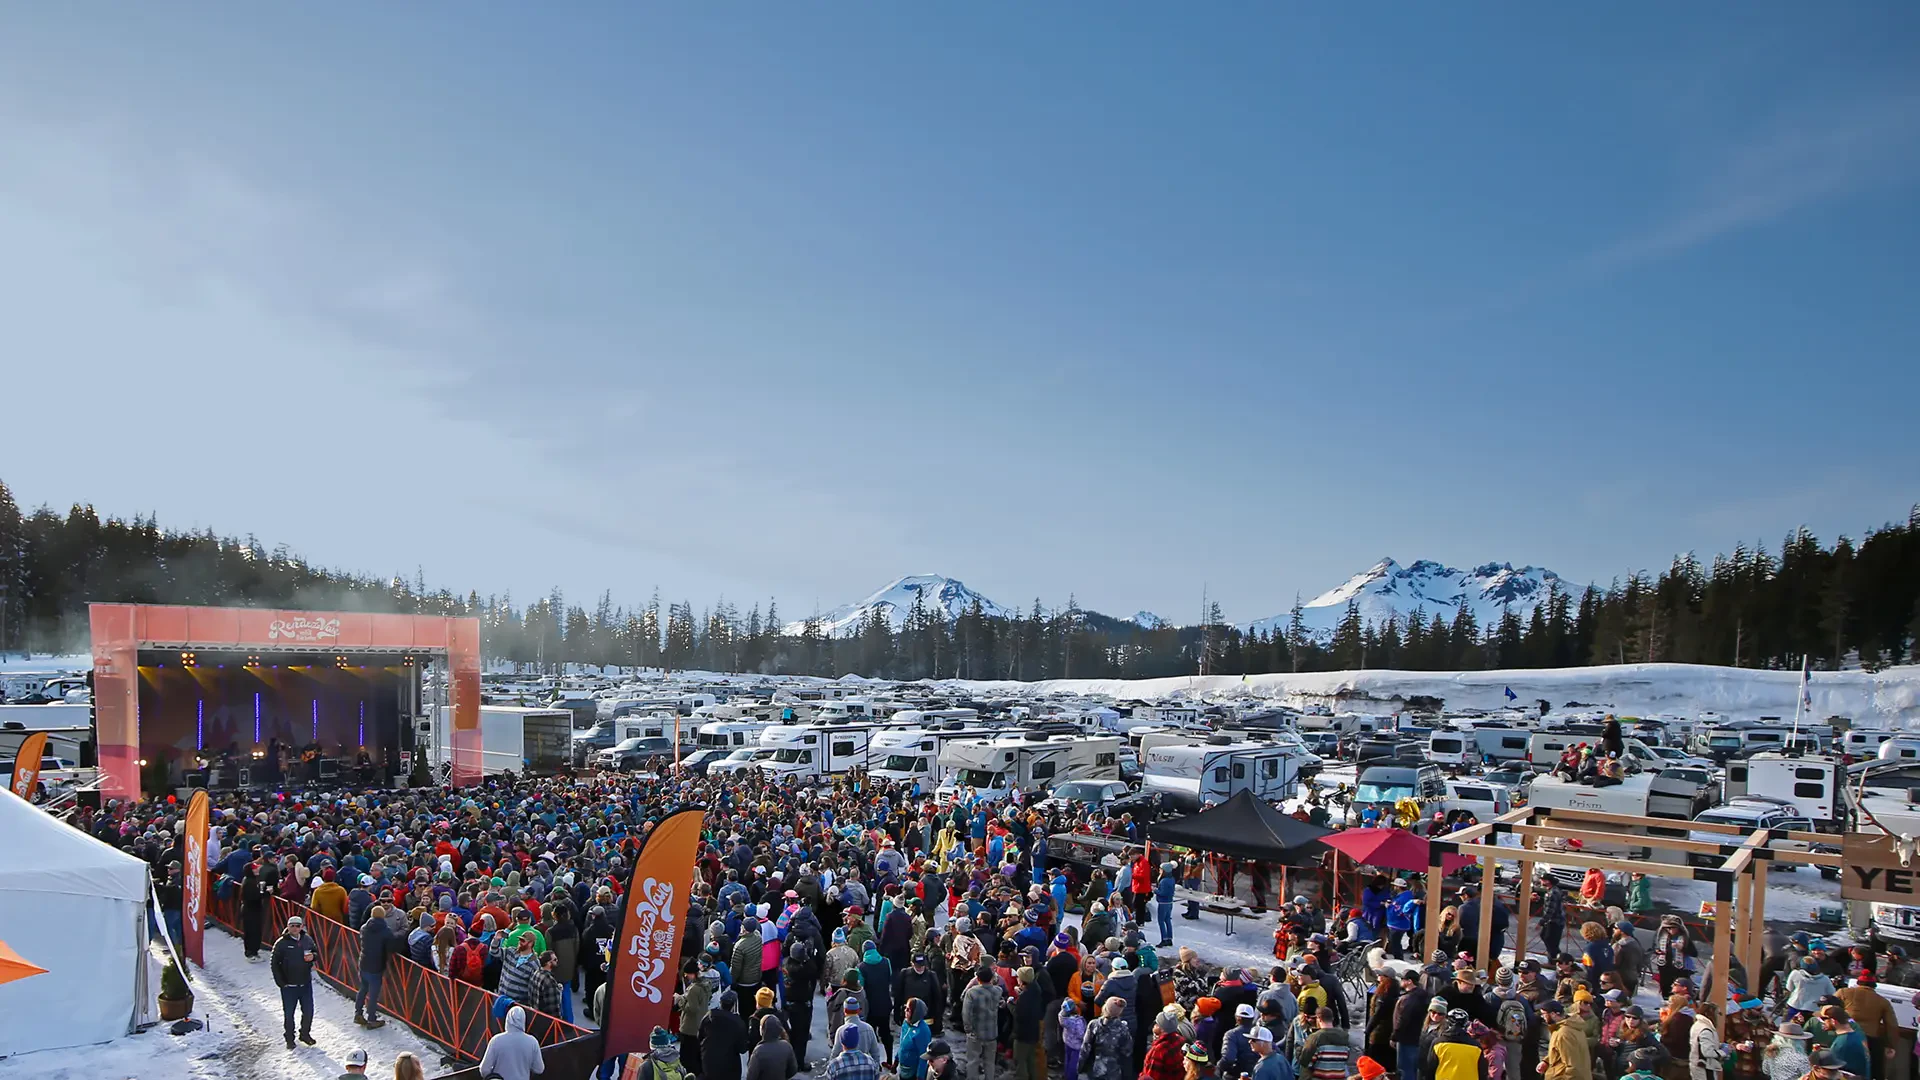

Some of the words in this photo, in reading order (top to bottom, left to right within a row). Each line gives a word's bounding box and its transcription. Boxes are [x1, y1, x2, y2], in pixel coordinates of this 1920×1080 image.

[1568, 799, 1602, 809] Prism
[1850, 865, 1920, 894] YE
[629, 877, 675, 1003] RendezVan
[660, 923, 676, 959] Bachelor
